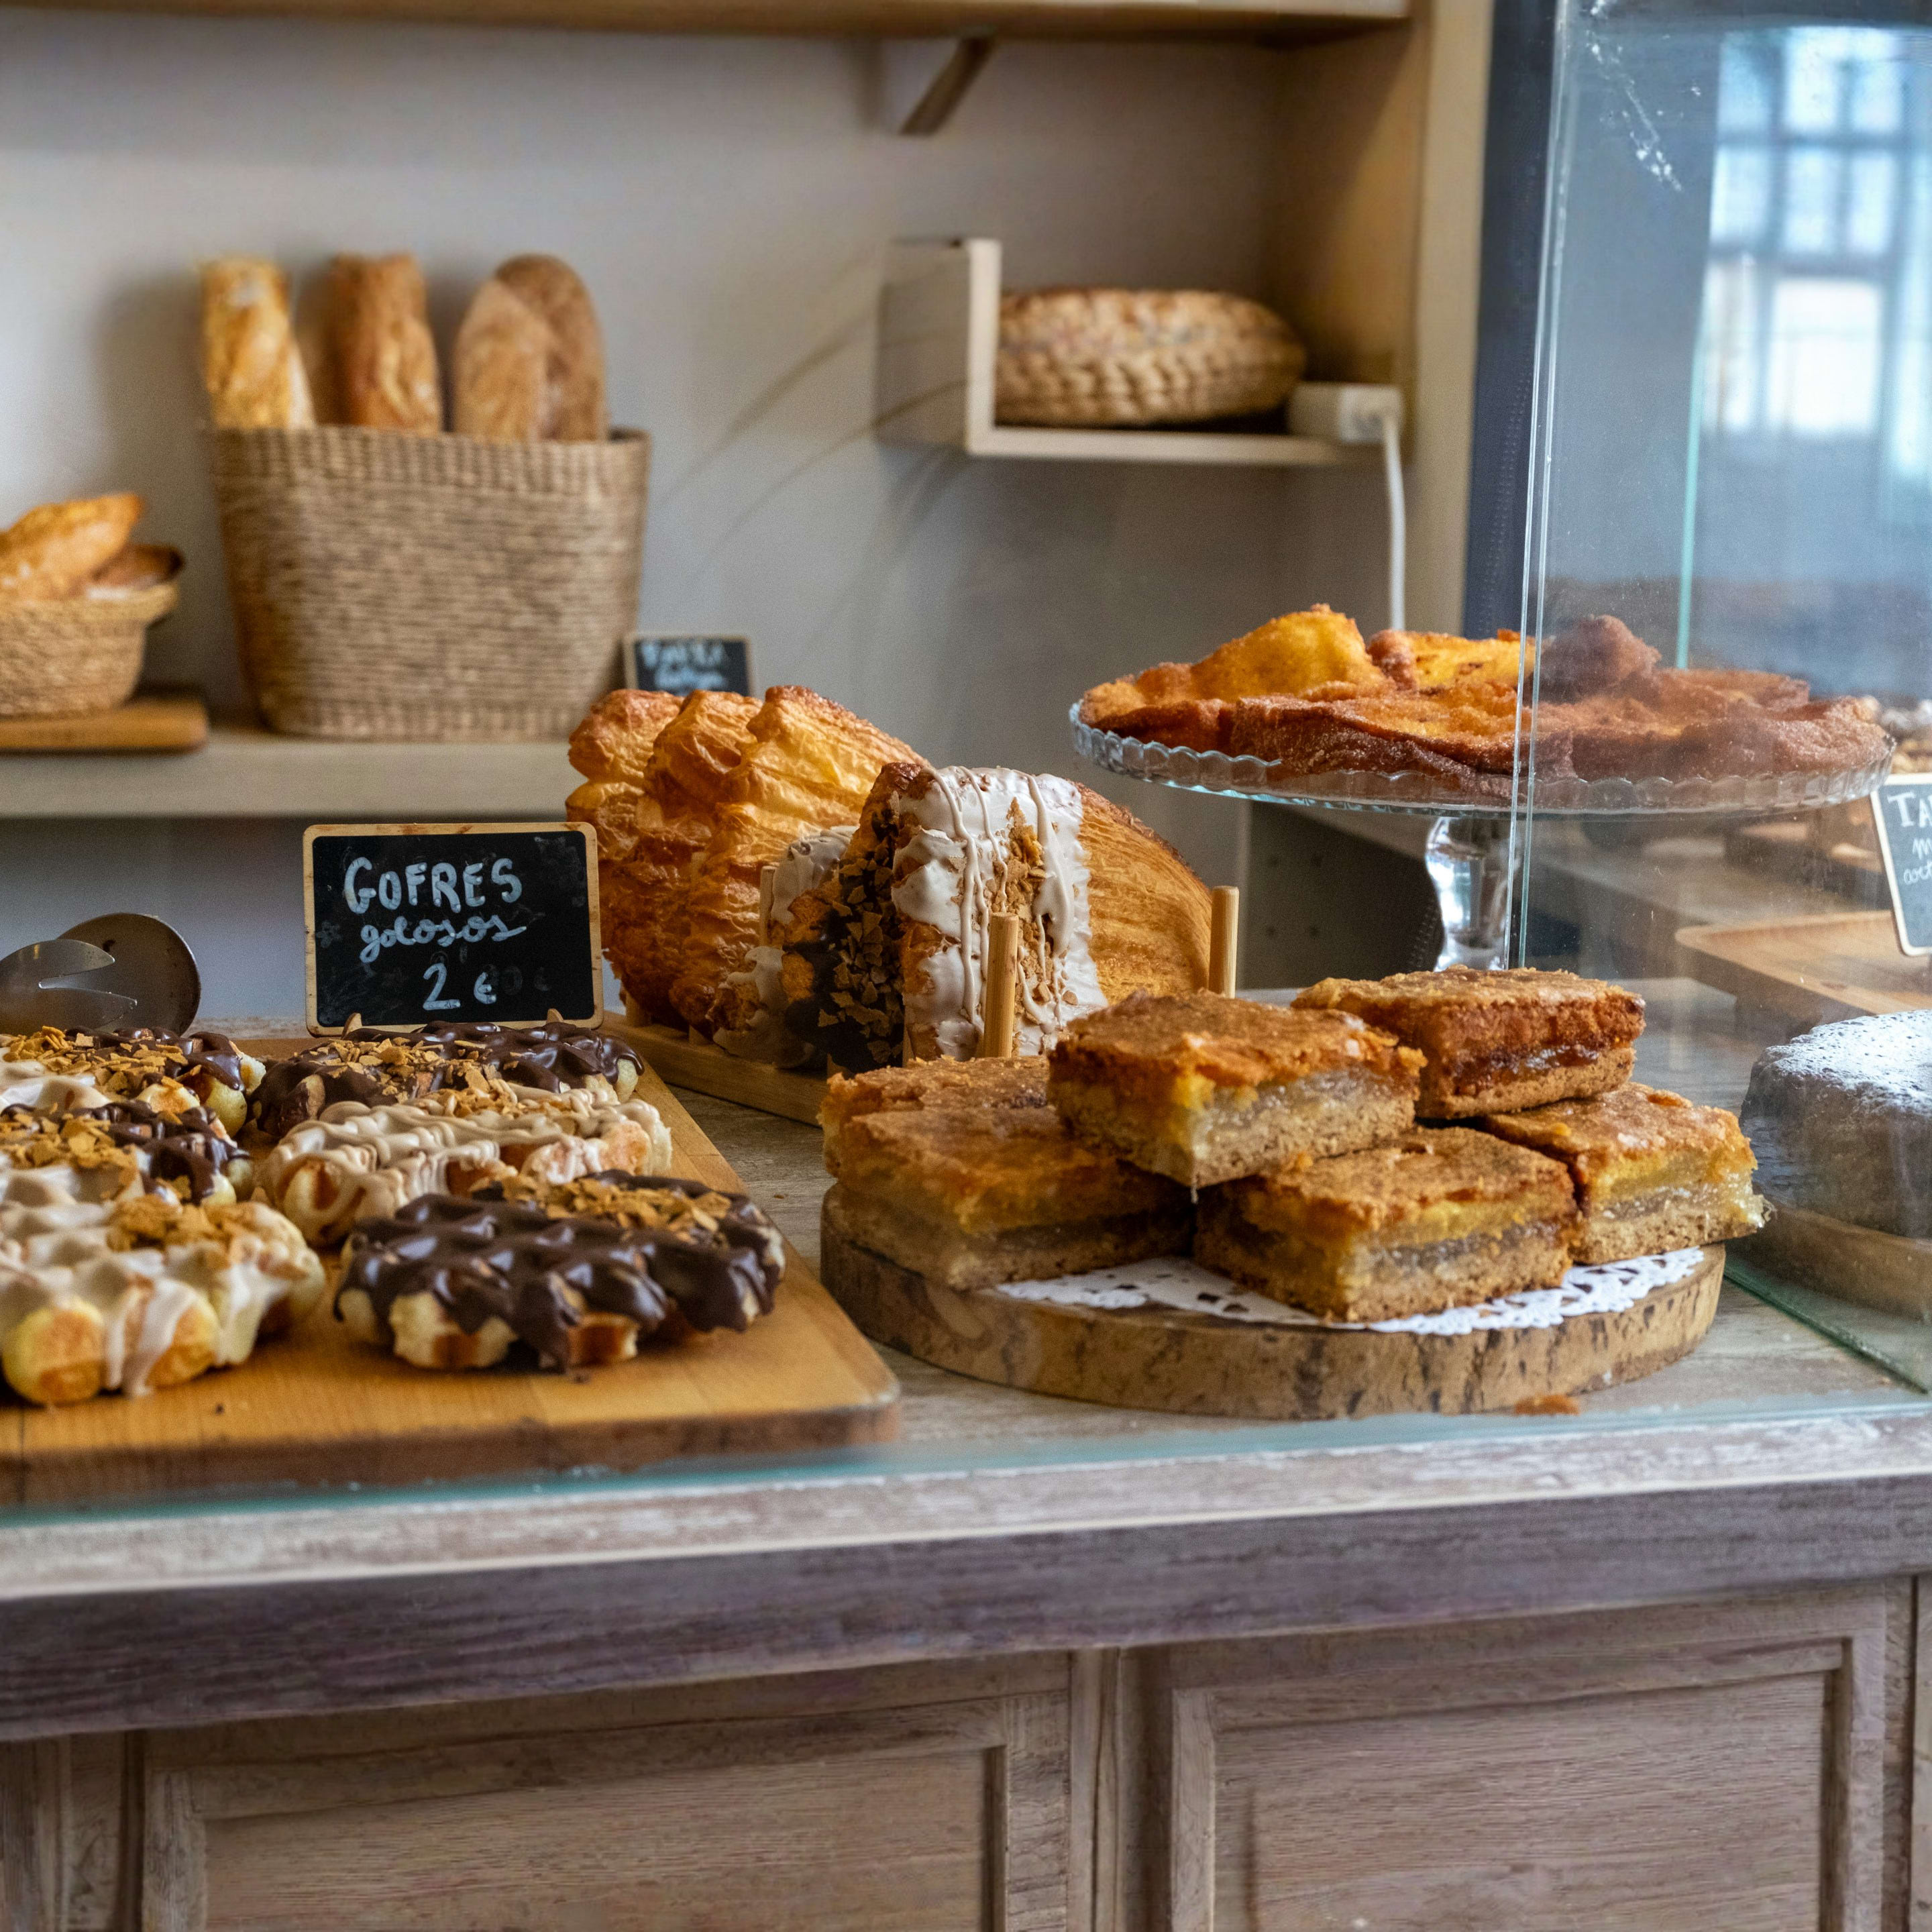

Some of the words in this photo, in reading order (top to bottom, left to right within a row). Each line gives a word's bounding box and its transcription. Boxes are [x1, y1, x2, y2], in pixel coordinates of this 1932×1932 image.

[1886, 792, 1932, 828] TA
[344, 857, 522, 914] GOFRES
[360, 915, 527, 963] golosos
